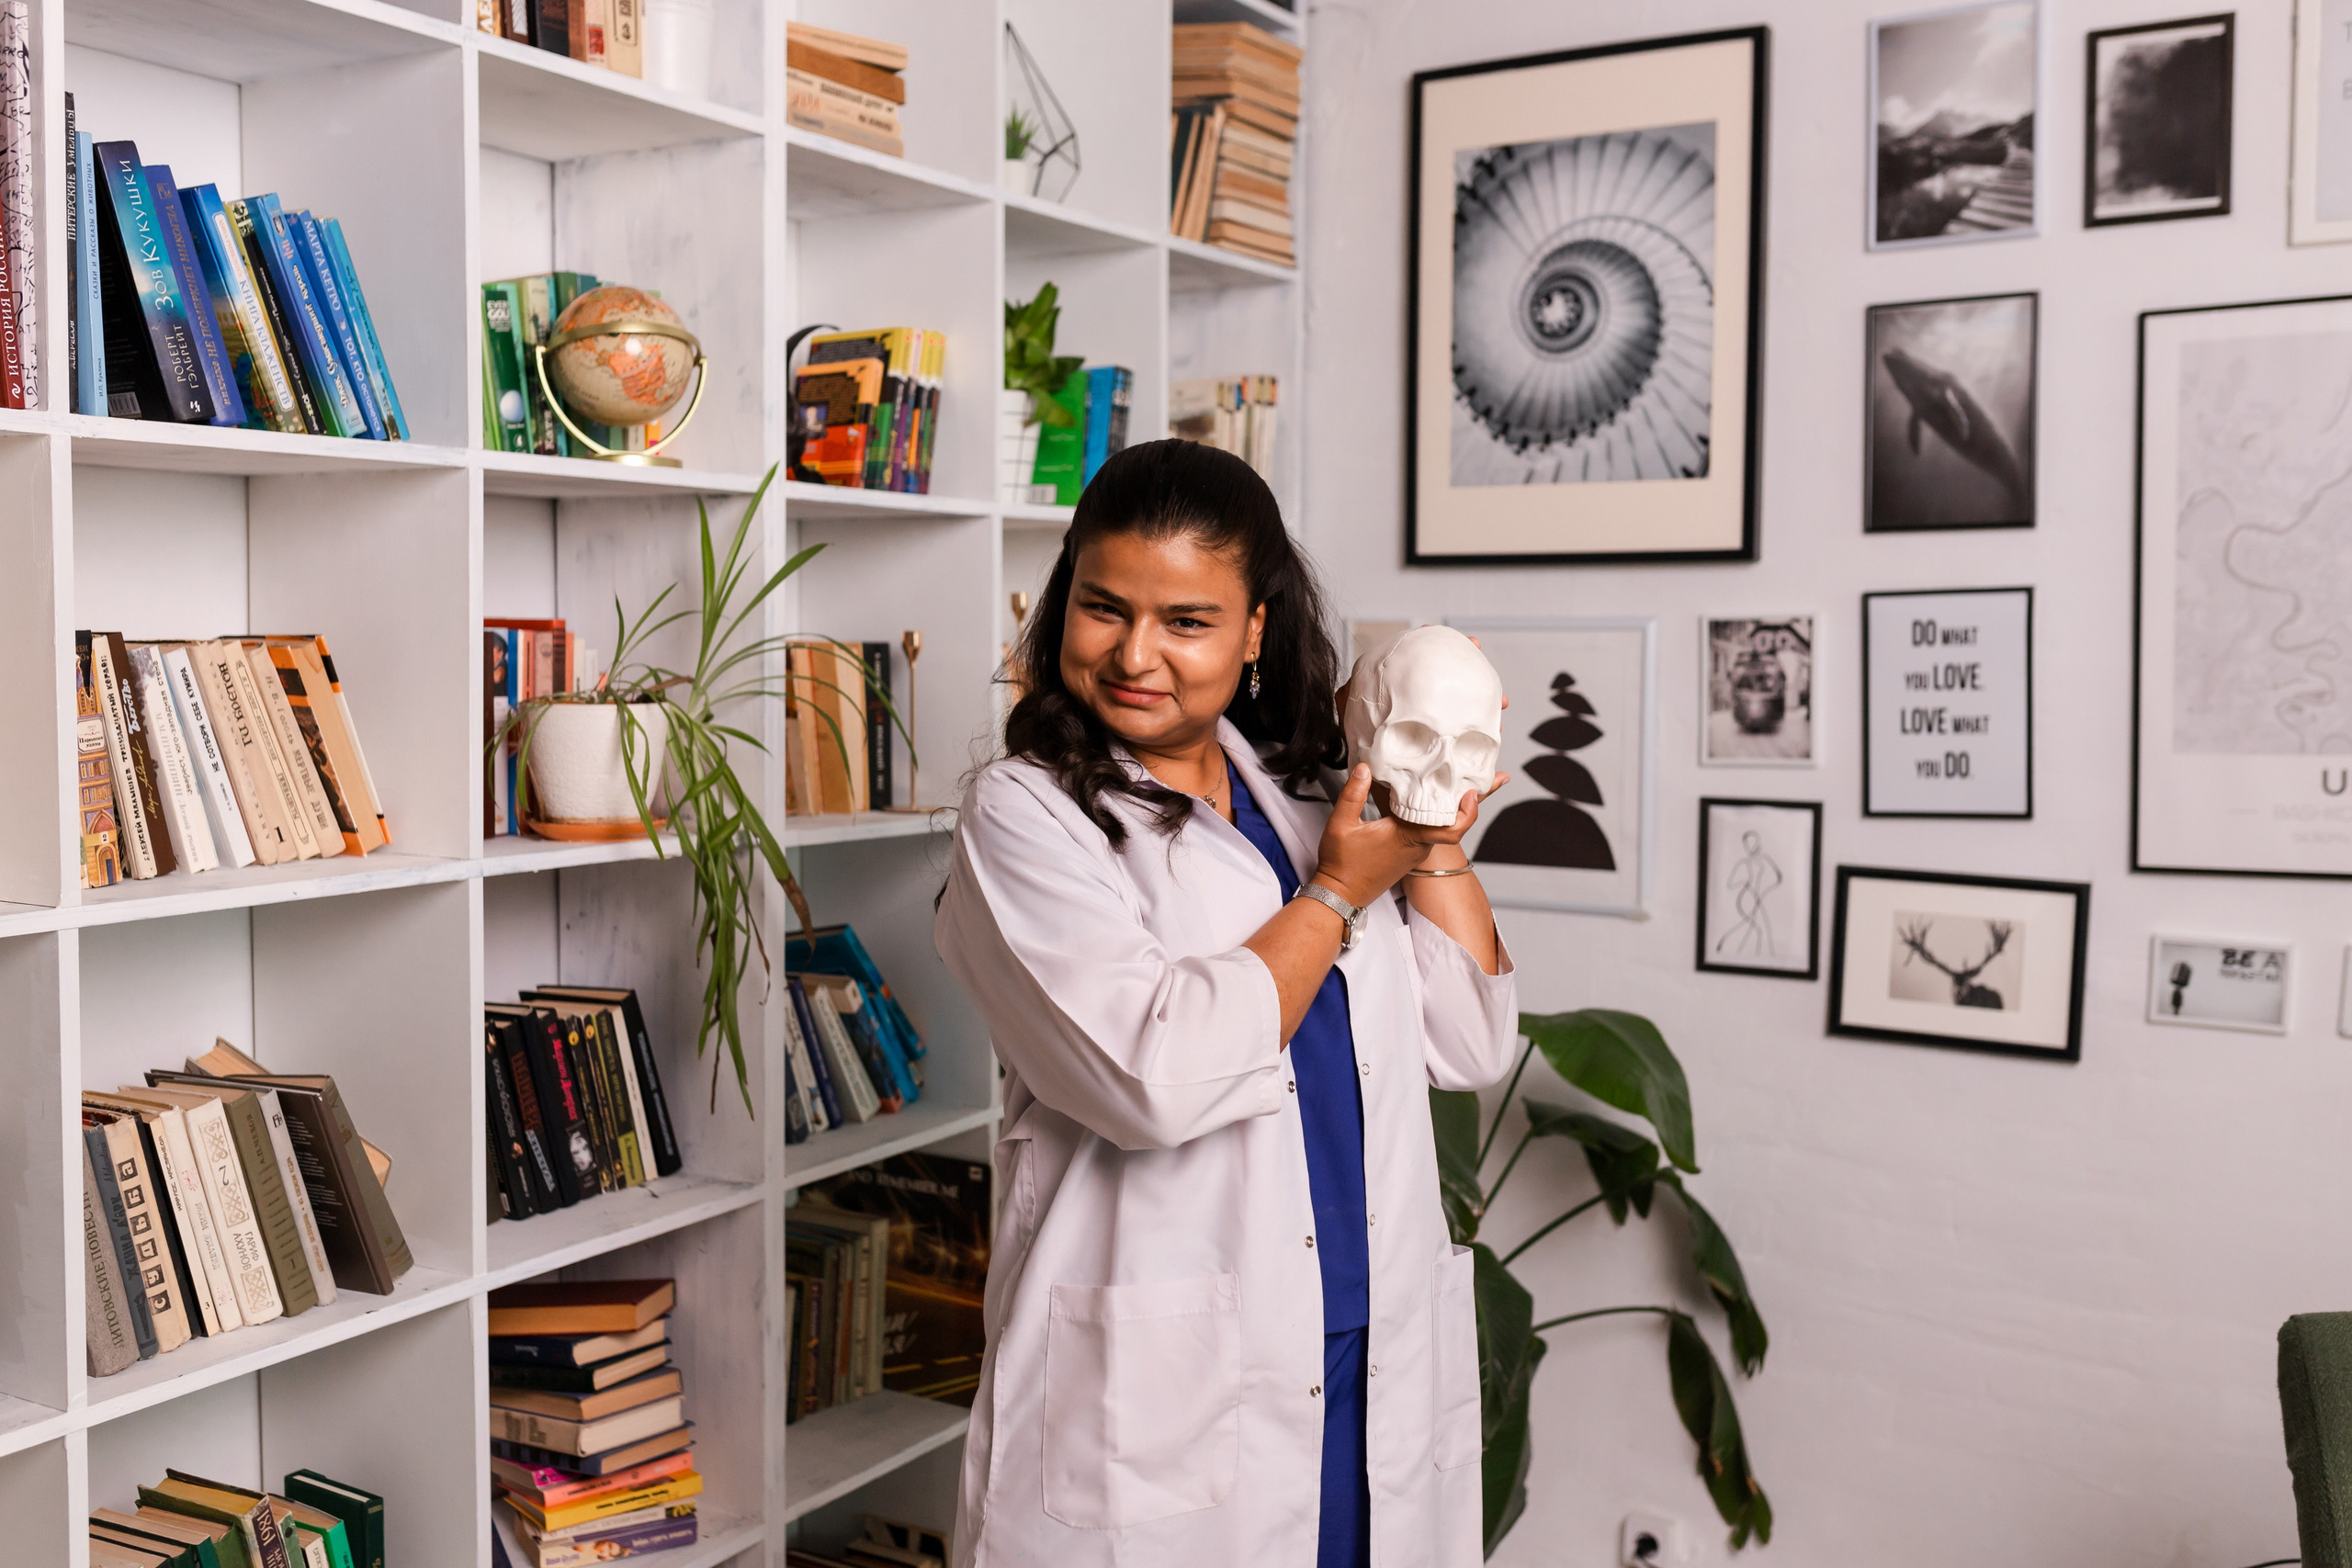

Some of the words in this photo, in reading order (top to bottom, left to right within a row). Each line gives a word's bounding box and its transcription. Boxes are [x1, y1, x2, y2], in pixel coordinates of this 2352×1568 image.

[67, 173, 76, 241] ПИТЕРСКИЕ
[304, 220, 324, 267] МАРТА
[321, 267, 342, 312] КЕТРО
[184, 265, 211, 337] ПОМЕРКНЕТ
[1, 298, 19, 376] ИСТОРИЯ
[206, 338, 220, 358] НЕ
[240, 279, 259, 325] КНИГА
[255, 323, 290, 407] БЛАЖЕНСТВ
[165, 333, 187, 382] РОБЕРТ
[175, 324, 199, 389] ГЭЛБРЕЙТ
[353, 361, 365, 381] КТО
[1912, 619, 1937, 647] DO
[1940, 627, 1978, 646] WHAT
[153, 660, 164, 686] стена
[180, 666, 198, 700] КУМИРА
[1905, 671, 1928, 690] YOU
[160, 690, 182, 759] юго-западная
[190, 701, 203, 722] СЕБЕ
[1900, 707, 1948, 734] LOVE
[1952, 716, 1989, 734] WHAT
[199, 723, 217, 760] СОТВОРИ
[211, 761, 221, 773] НЕ
[1916, 760, 1940, 778] YOU
[127, 768, 143, 819] МАЛЫШЕВ
[292, 749, 316, 795] МЕРТВЫЕ
[311, 799, 329, 830] ДУШИ
[156, 1134, 174, 1179] КАСТАНЕДА
[218, 1165, 231, 1187] 2
[168, 1180, 183, 1213] КАРЛОС
[194, 1201, 210, 1232] РАХИМ
[204, 1234, 221, 1271] ДЖАЛИЛ
[232, 1232, 253, 1272] АХУНОВ
[243, 1231, 261, 1262] ГАРИФ
[93, 1266, 125, 1349] ЛИТОВСКИЕ
